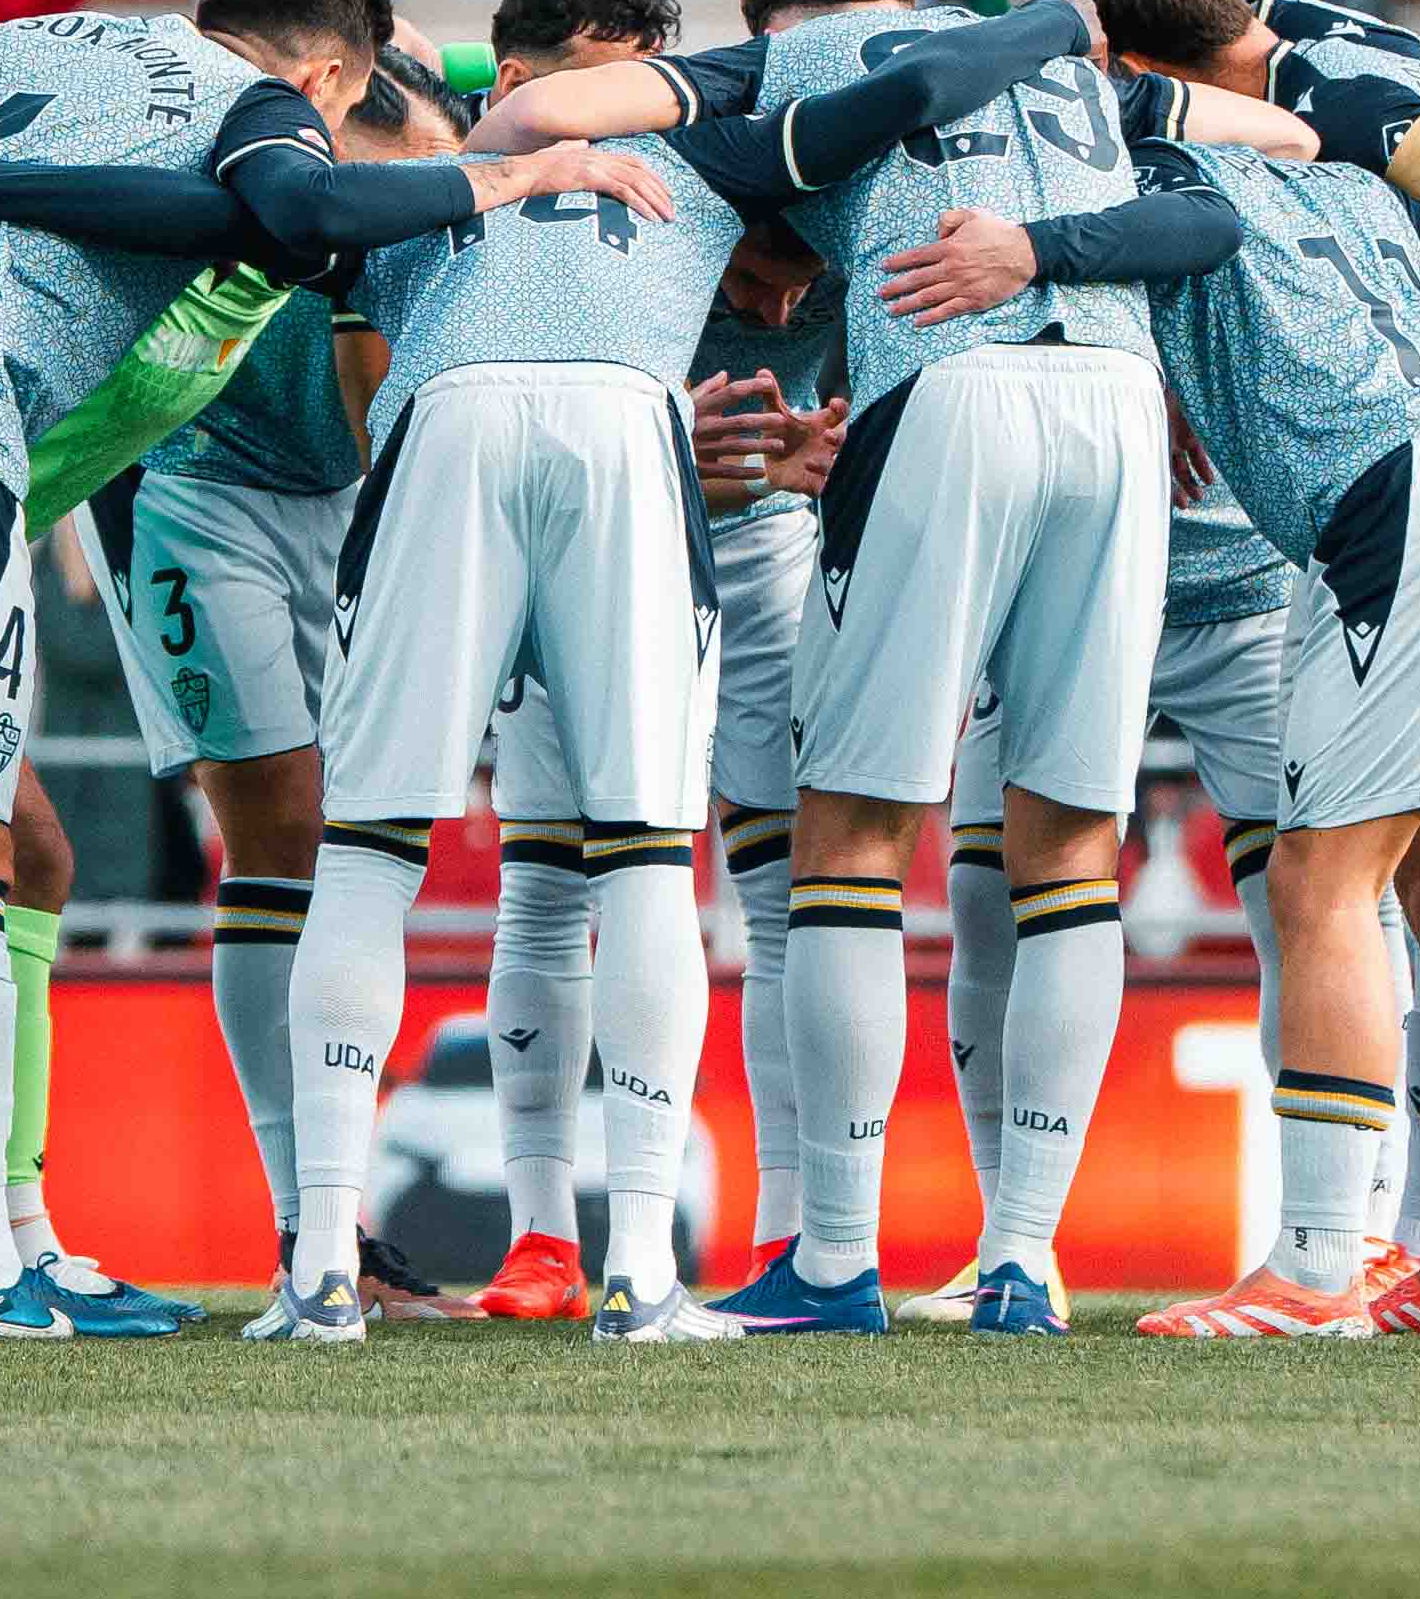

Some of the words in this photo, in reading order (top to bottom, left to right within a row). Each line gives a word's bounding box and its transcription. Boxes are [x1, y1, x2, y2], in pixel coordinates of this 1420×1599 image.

[150, 567, 196, 657] 3
[324, 1043, 375, 1082] UDA
[611, 1067, 672, 1105] UDA
[849, 1119, 887, 1140] UD
[1012, 1107, 1069, 1135] UDA
